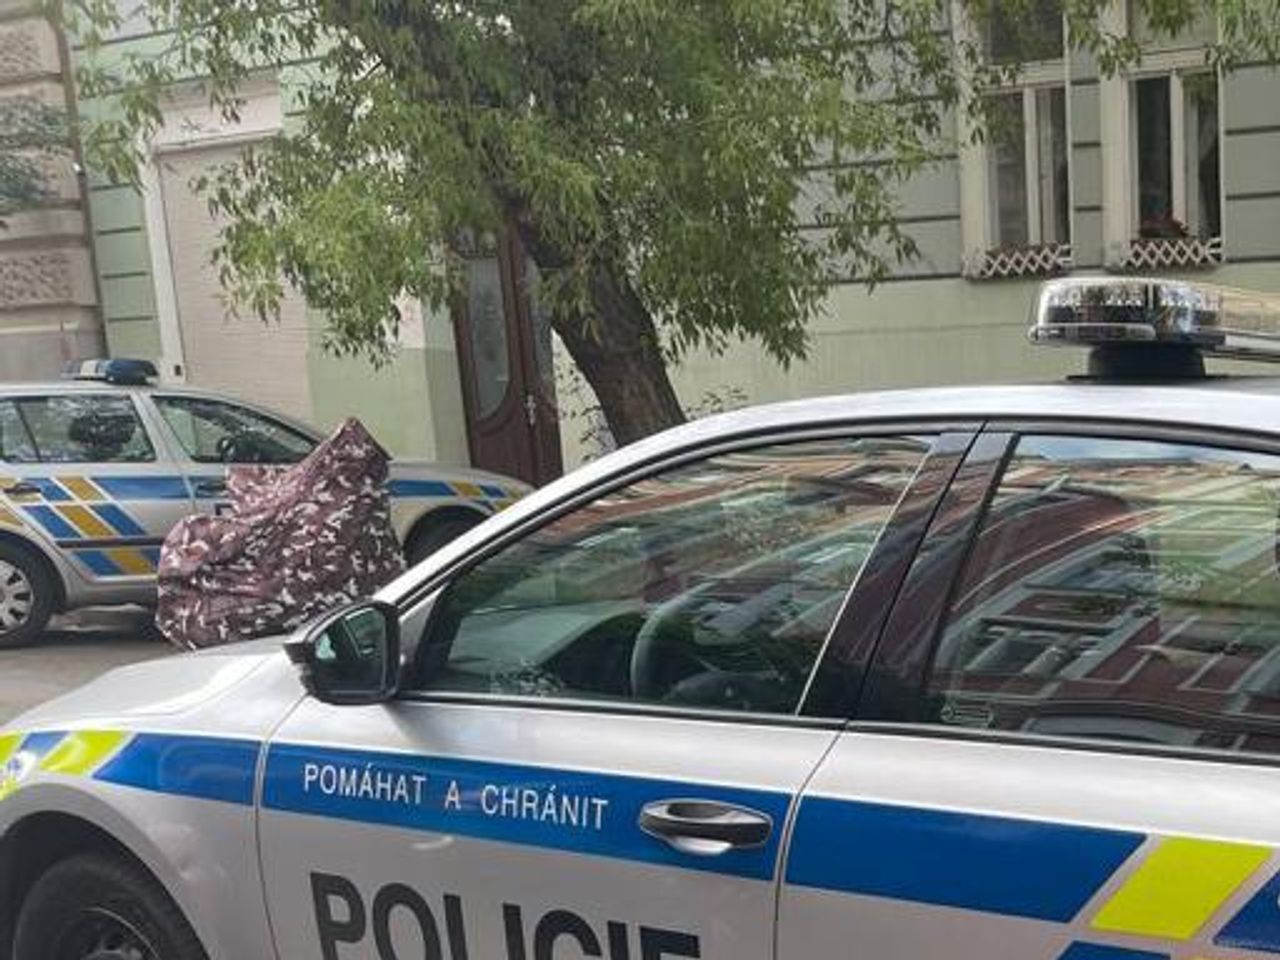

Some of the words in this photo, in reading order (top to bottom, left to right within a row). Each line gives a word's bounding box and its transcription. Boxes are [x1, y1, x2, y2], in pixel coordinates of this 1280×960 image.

[304, 763, 427, 806] POMÁHAT
[444, 781, 462, 810] A
[481, 785, 609, 830] CHRÁNIT
